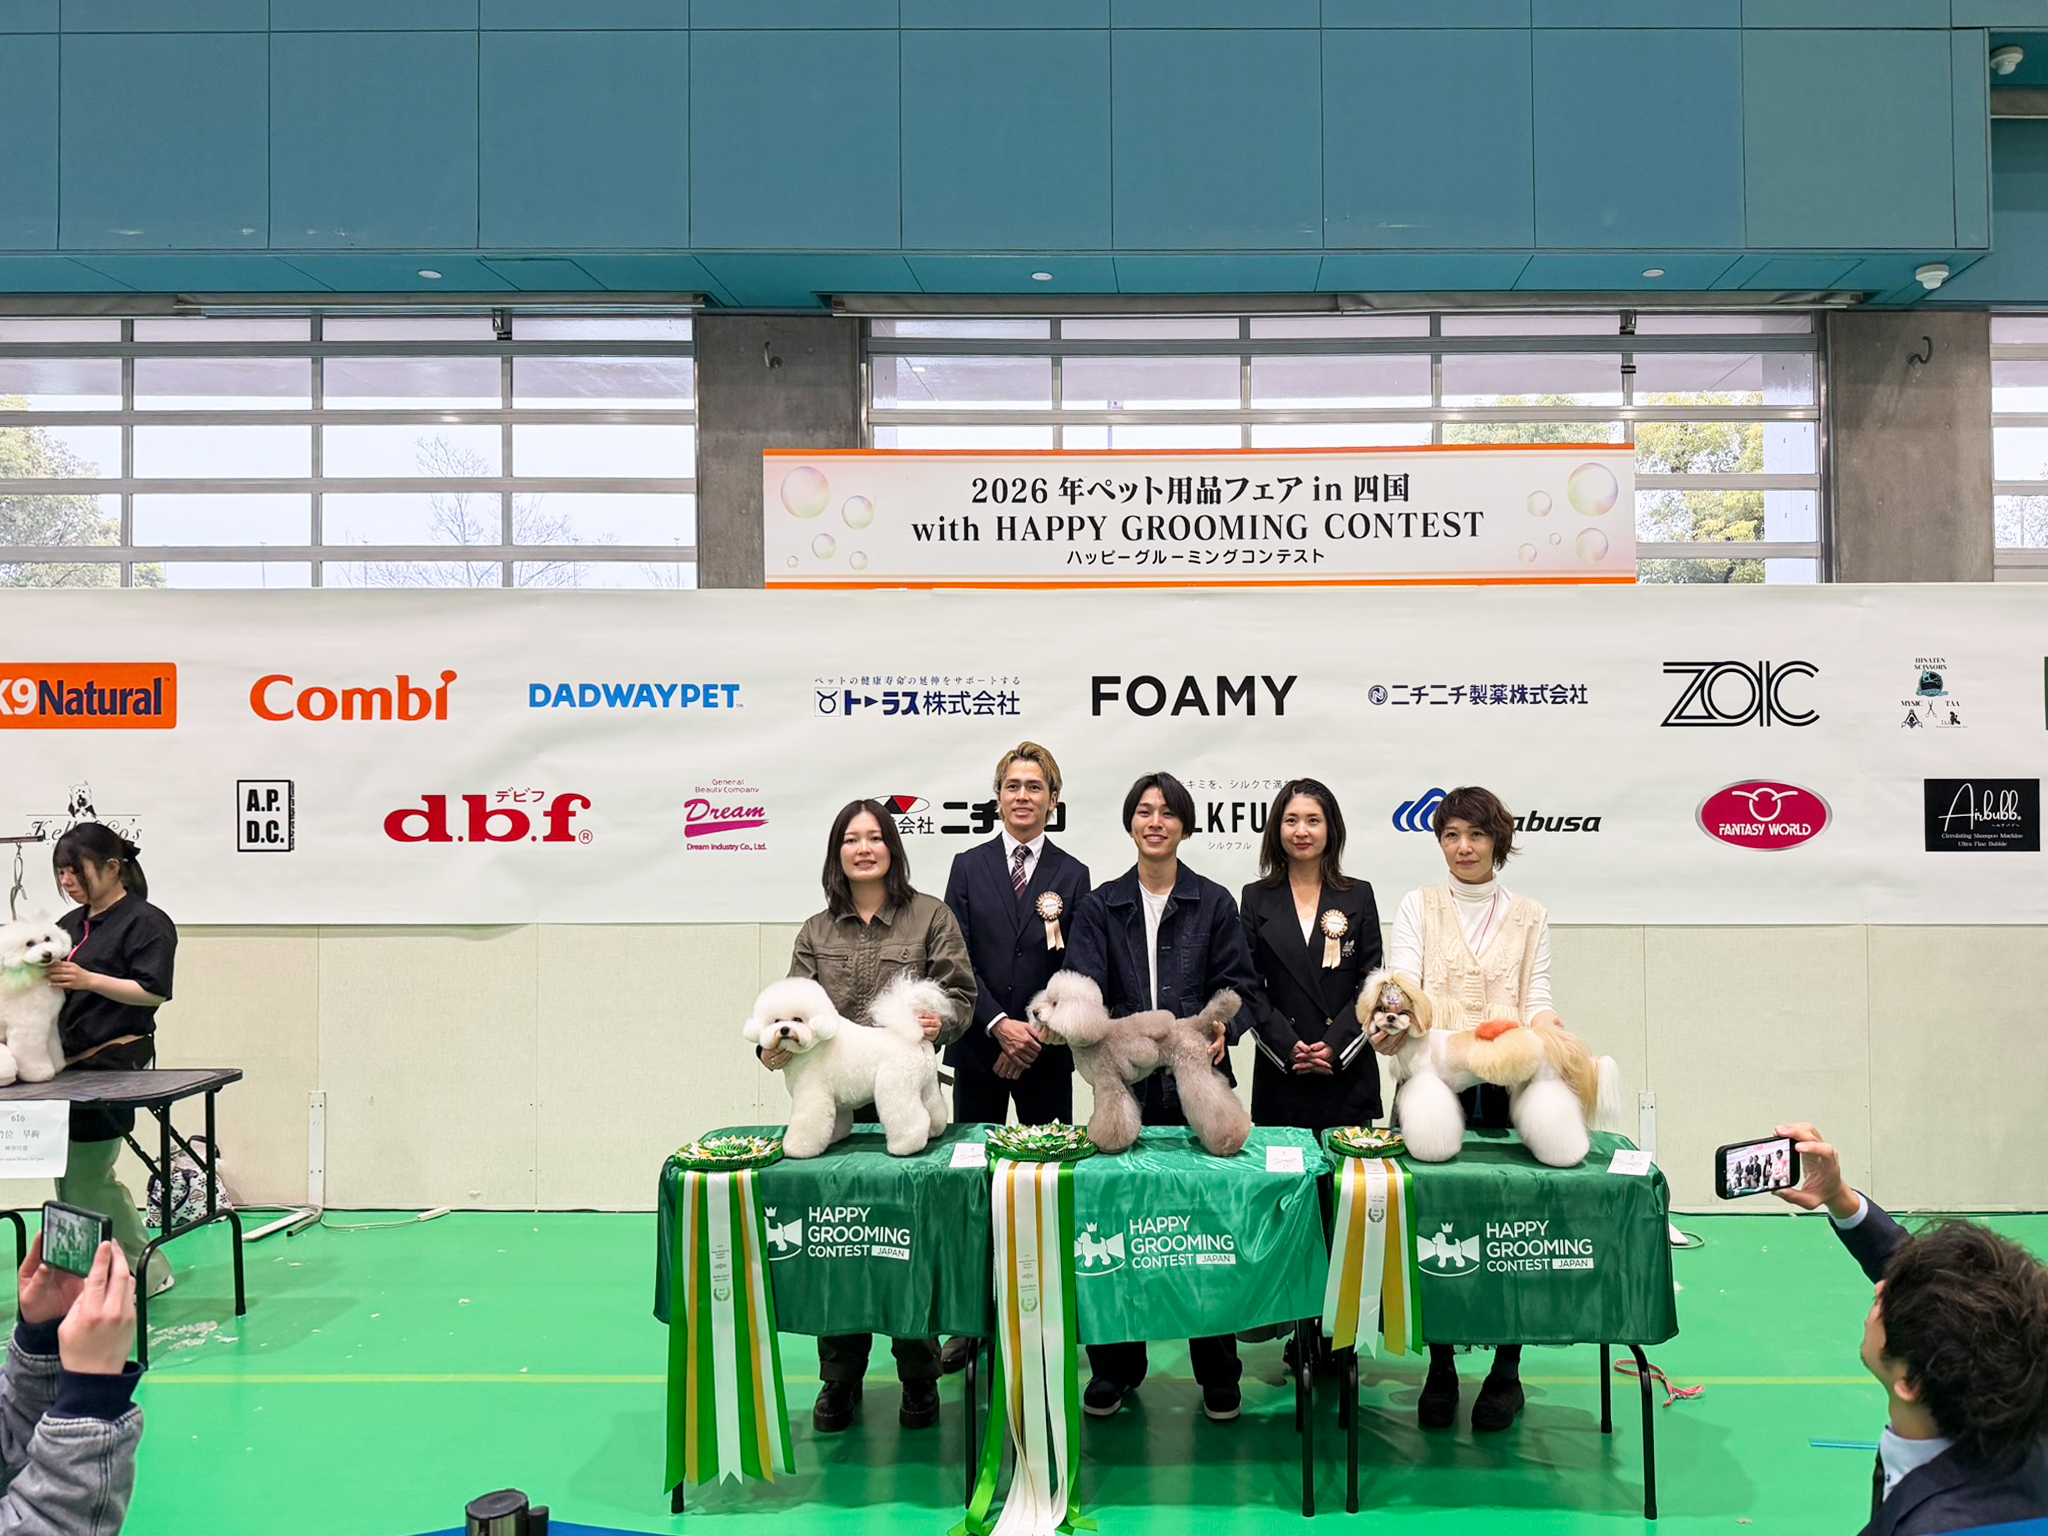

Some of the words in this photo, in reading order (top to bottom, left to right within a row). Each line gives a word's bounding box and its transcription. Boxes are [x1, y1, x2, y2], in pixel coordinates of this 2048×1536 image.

[972, 477, 1048, 504] 2026
[1059, 475, 1303, 505] 年ペット用品フェア
[1313, 476, 1342, 501] in
[1354, 473, 1409, 502] 四国
[912, 515, 980, 541] with
[996, 515, 1107, 541] HAPPY
[1121, 514, 1309, 541] GROOMING
[1324, 511, 1484, 539] CONTEST
[1067, 549, 1324, 565] ハッピーグルーミングコンテスト
[250, 669, 457, 721] Combi
[1091, 675, 1298, 716] FOAMY
[1391, 683, 1588, 706] ニチニチ製薬株式会社
[1660, 660, 1820, 728] ZOIC
[246, 788, 280, 812] A.P.
[495, 786, 545, 803] デビフ
[724, 786, 760, 794] Company
[683, 798, 766, 822] Dream
[246, 820, 285, 843] D.C.
[1719, 823, 1765, 836] FANTASY
[1768, 823, 1811, 836] WORLD
[686, 843, 710, 851] Dream
[711, 843, 739, 852] Industry
[1207, 841, 1252, 850] シルクフル
[10, 1114, 26, 1122] 616
[808, 1206, 871, 1223] HAPPY
[1129, 1215, 1191, 1235] HAPPY
[1486, 1220, 1549, 1238] HAPPY
[807, 1225, 911, 1246] GROOMING
[1131, 1234, 1235, 1254] GROOMING
[807, 1244, 870, 1258] CONTEST
[876, 1247, 905, 1258] JAPAN
[1486, 1238, 1593, 1258] GROOMING
[1132, 1253, 1194, 1269] CONTEST
[1201, 1255, 1231, 1263] JAPAN
[1486, 1258, 1551, 1272] CONTEST
[1558, 1259, 1588, 1268] JAPAN
